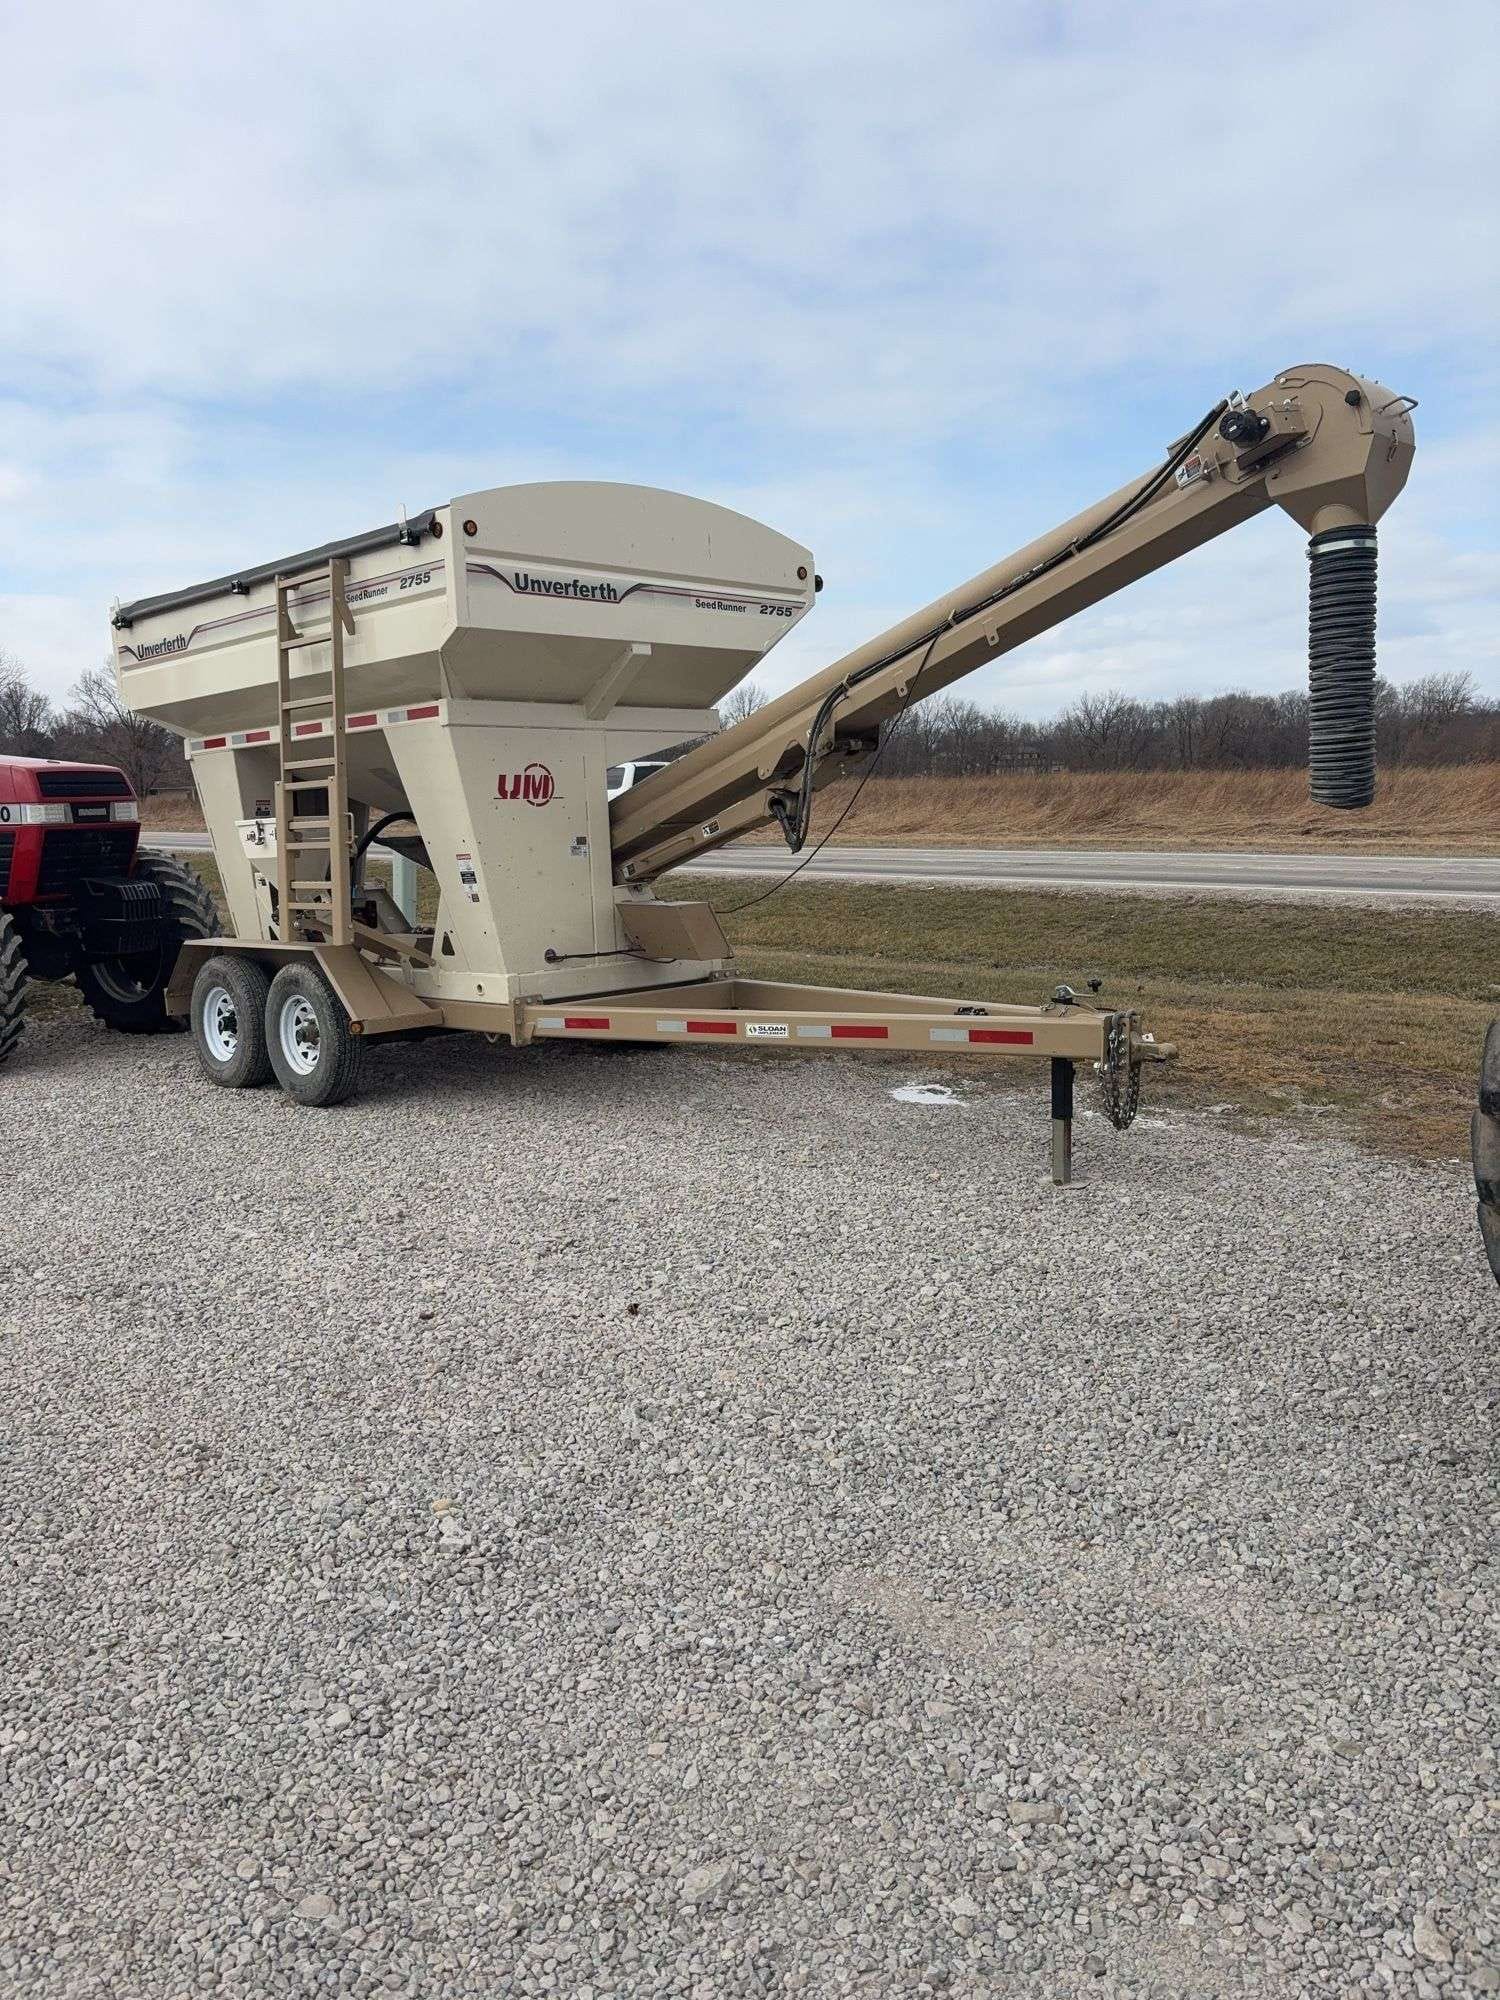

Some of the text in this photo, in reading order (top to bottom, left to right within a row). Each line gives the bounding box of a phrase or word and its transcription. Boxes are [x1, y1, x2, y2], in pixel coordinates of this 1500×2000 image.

[399, 571, 431, 590] 2755
[514, 572, 618, 600] Unverferth
[759, 604, 793, 618] 2755
[137, 633, 186, 658] Unverferth
